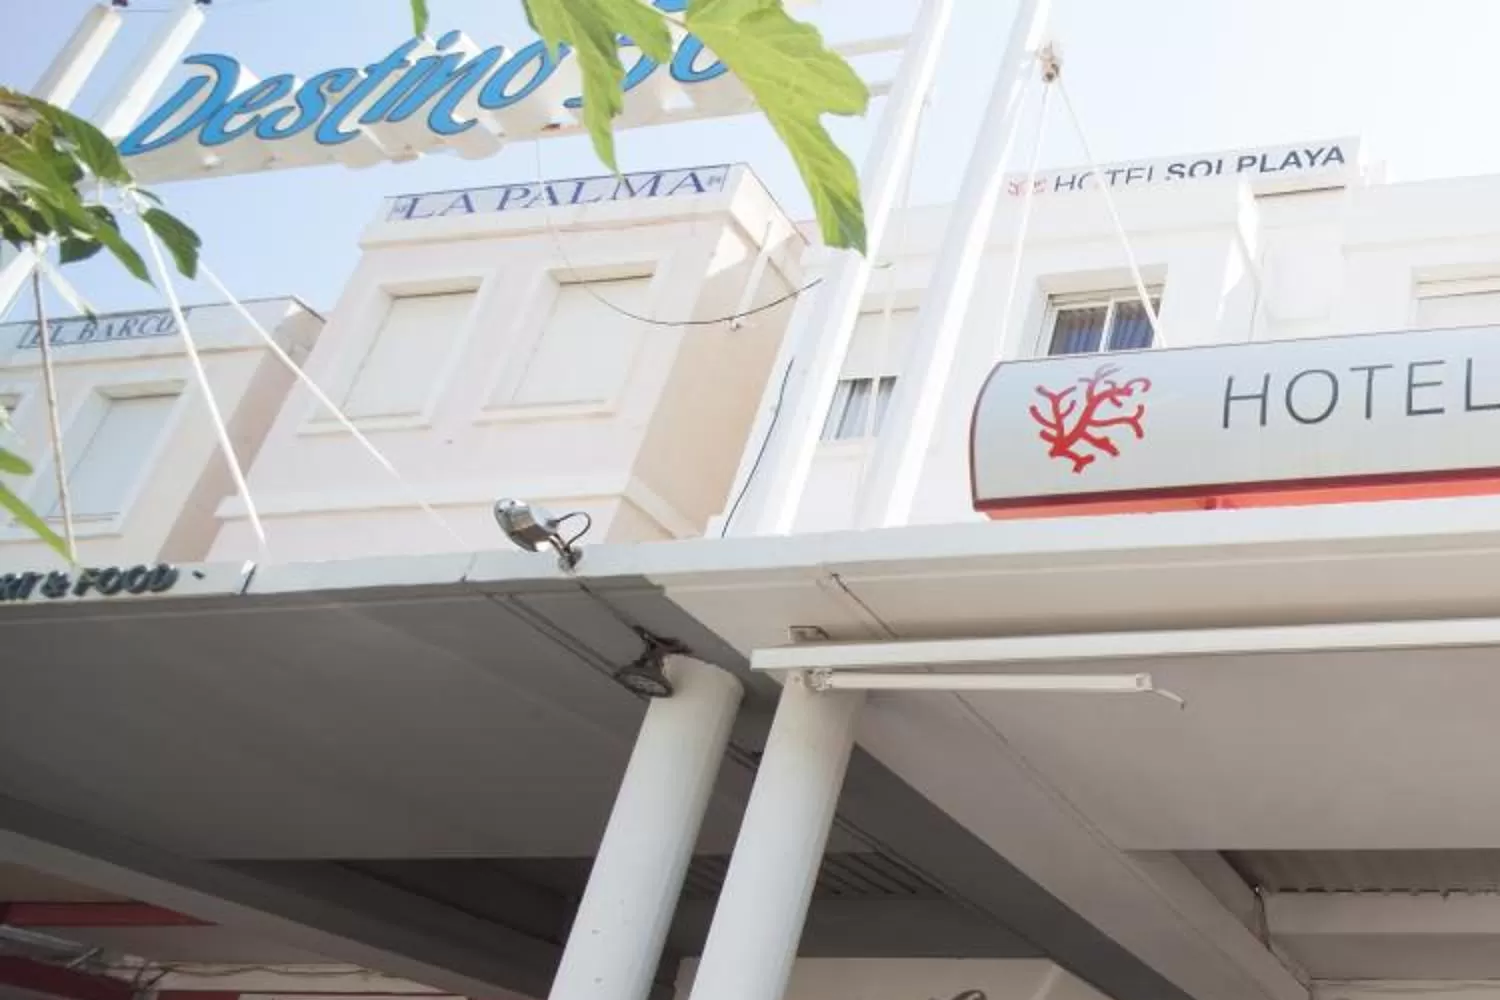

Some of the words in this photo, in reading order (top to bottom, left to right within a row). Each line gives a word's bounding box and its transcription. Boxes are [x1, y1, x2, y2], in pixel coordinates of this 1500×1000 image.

[115, 29, 572, 157] Destino
[404, 191, 476, 220] LA
[496, 170, 707, 212] PALMA
[72, 563, 179, 597] FOOD
